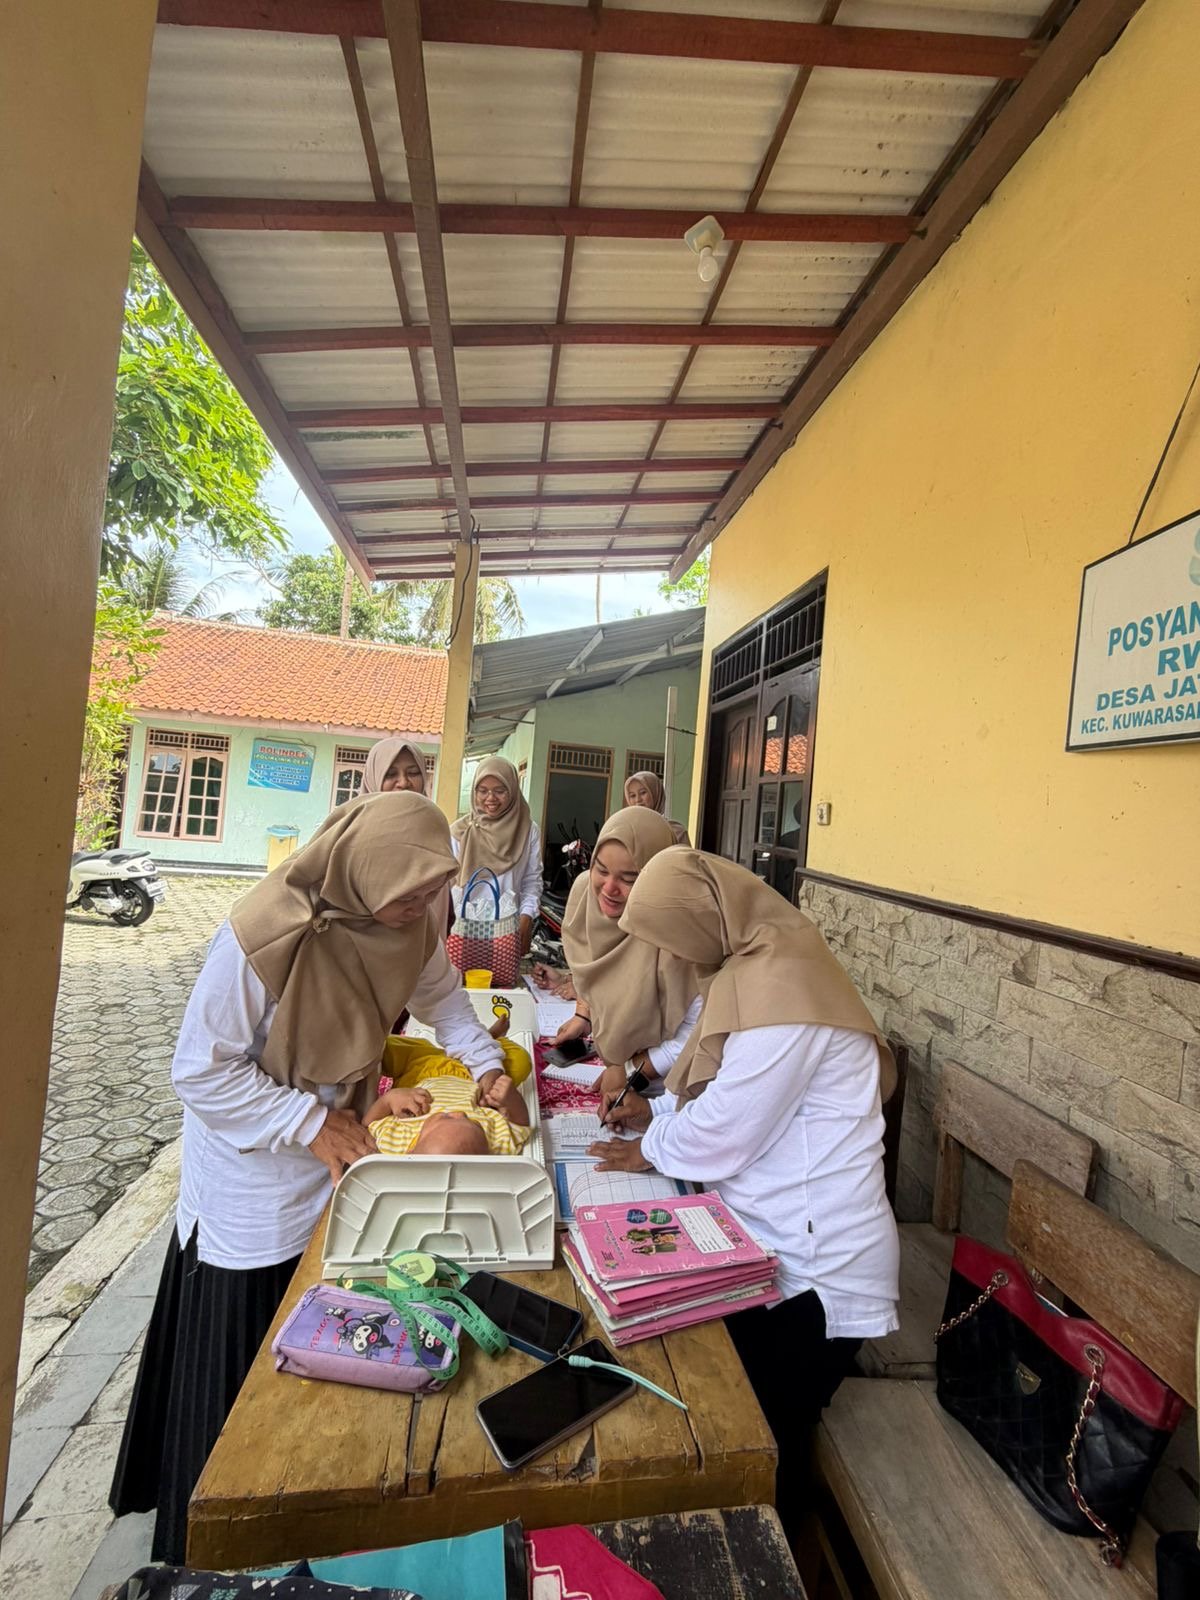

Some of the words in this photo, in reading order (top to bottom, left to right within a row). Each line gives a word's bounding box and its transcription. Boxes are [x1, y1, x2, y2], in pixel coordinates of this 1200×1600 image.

[1096, 684, 1155, 711] DESA
[1163, 675, 1200, 700] JA
[1081, 716, 1109, 734] KEC.
